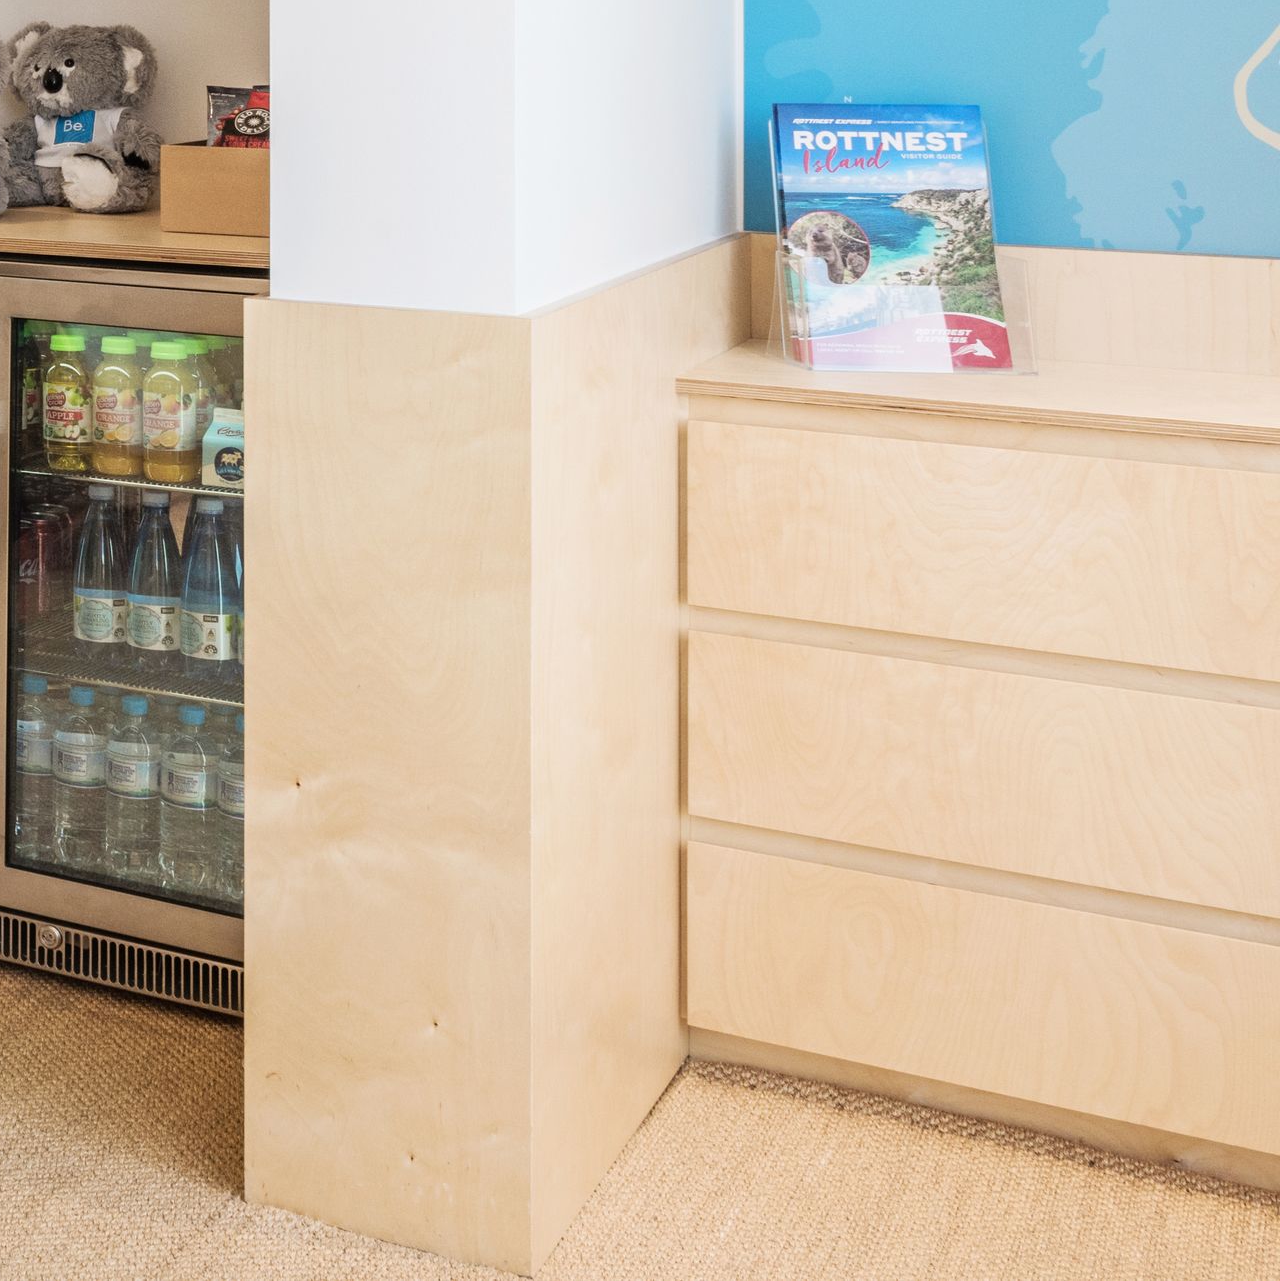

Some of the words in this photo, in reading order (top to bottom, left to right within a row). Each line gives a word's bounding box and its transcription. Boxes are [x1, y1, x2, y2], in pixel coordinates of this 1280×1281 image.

[237, 111, 253, 123] RED
[63, 120, 85, 132] Be.
[793, 130, 968, 152] ROTTNEST
[803, 142, 889, 174] Island
[47, 411, 74, 420] APPLE
[97, 413, 130, 423] ORANGE
[144, 420, 175, 429] RANGE
